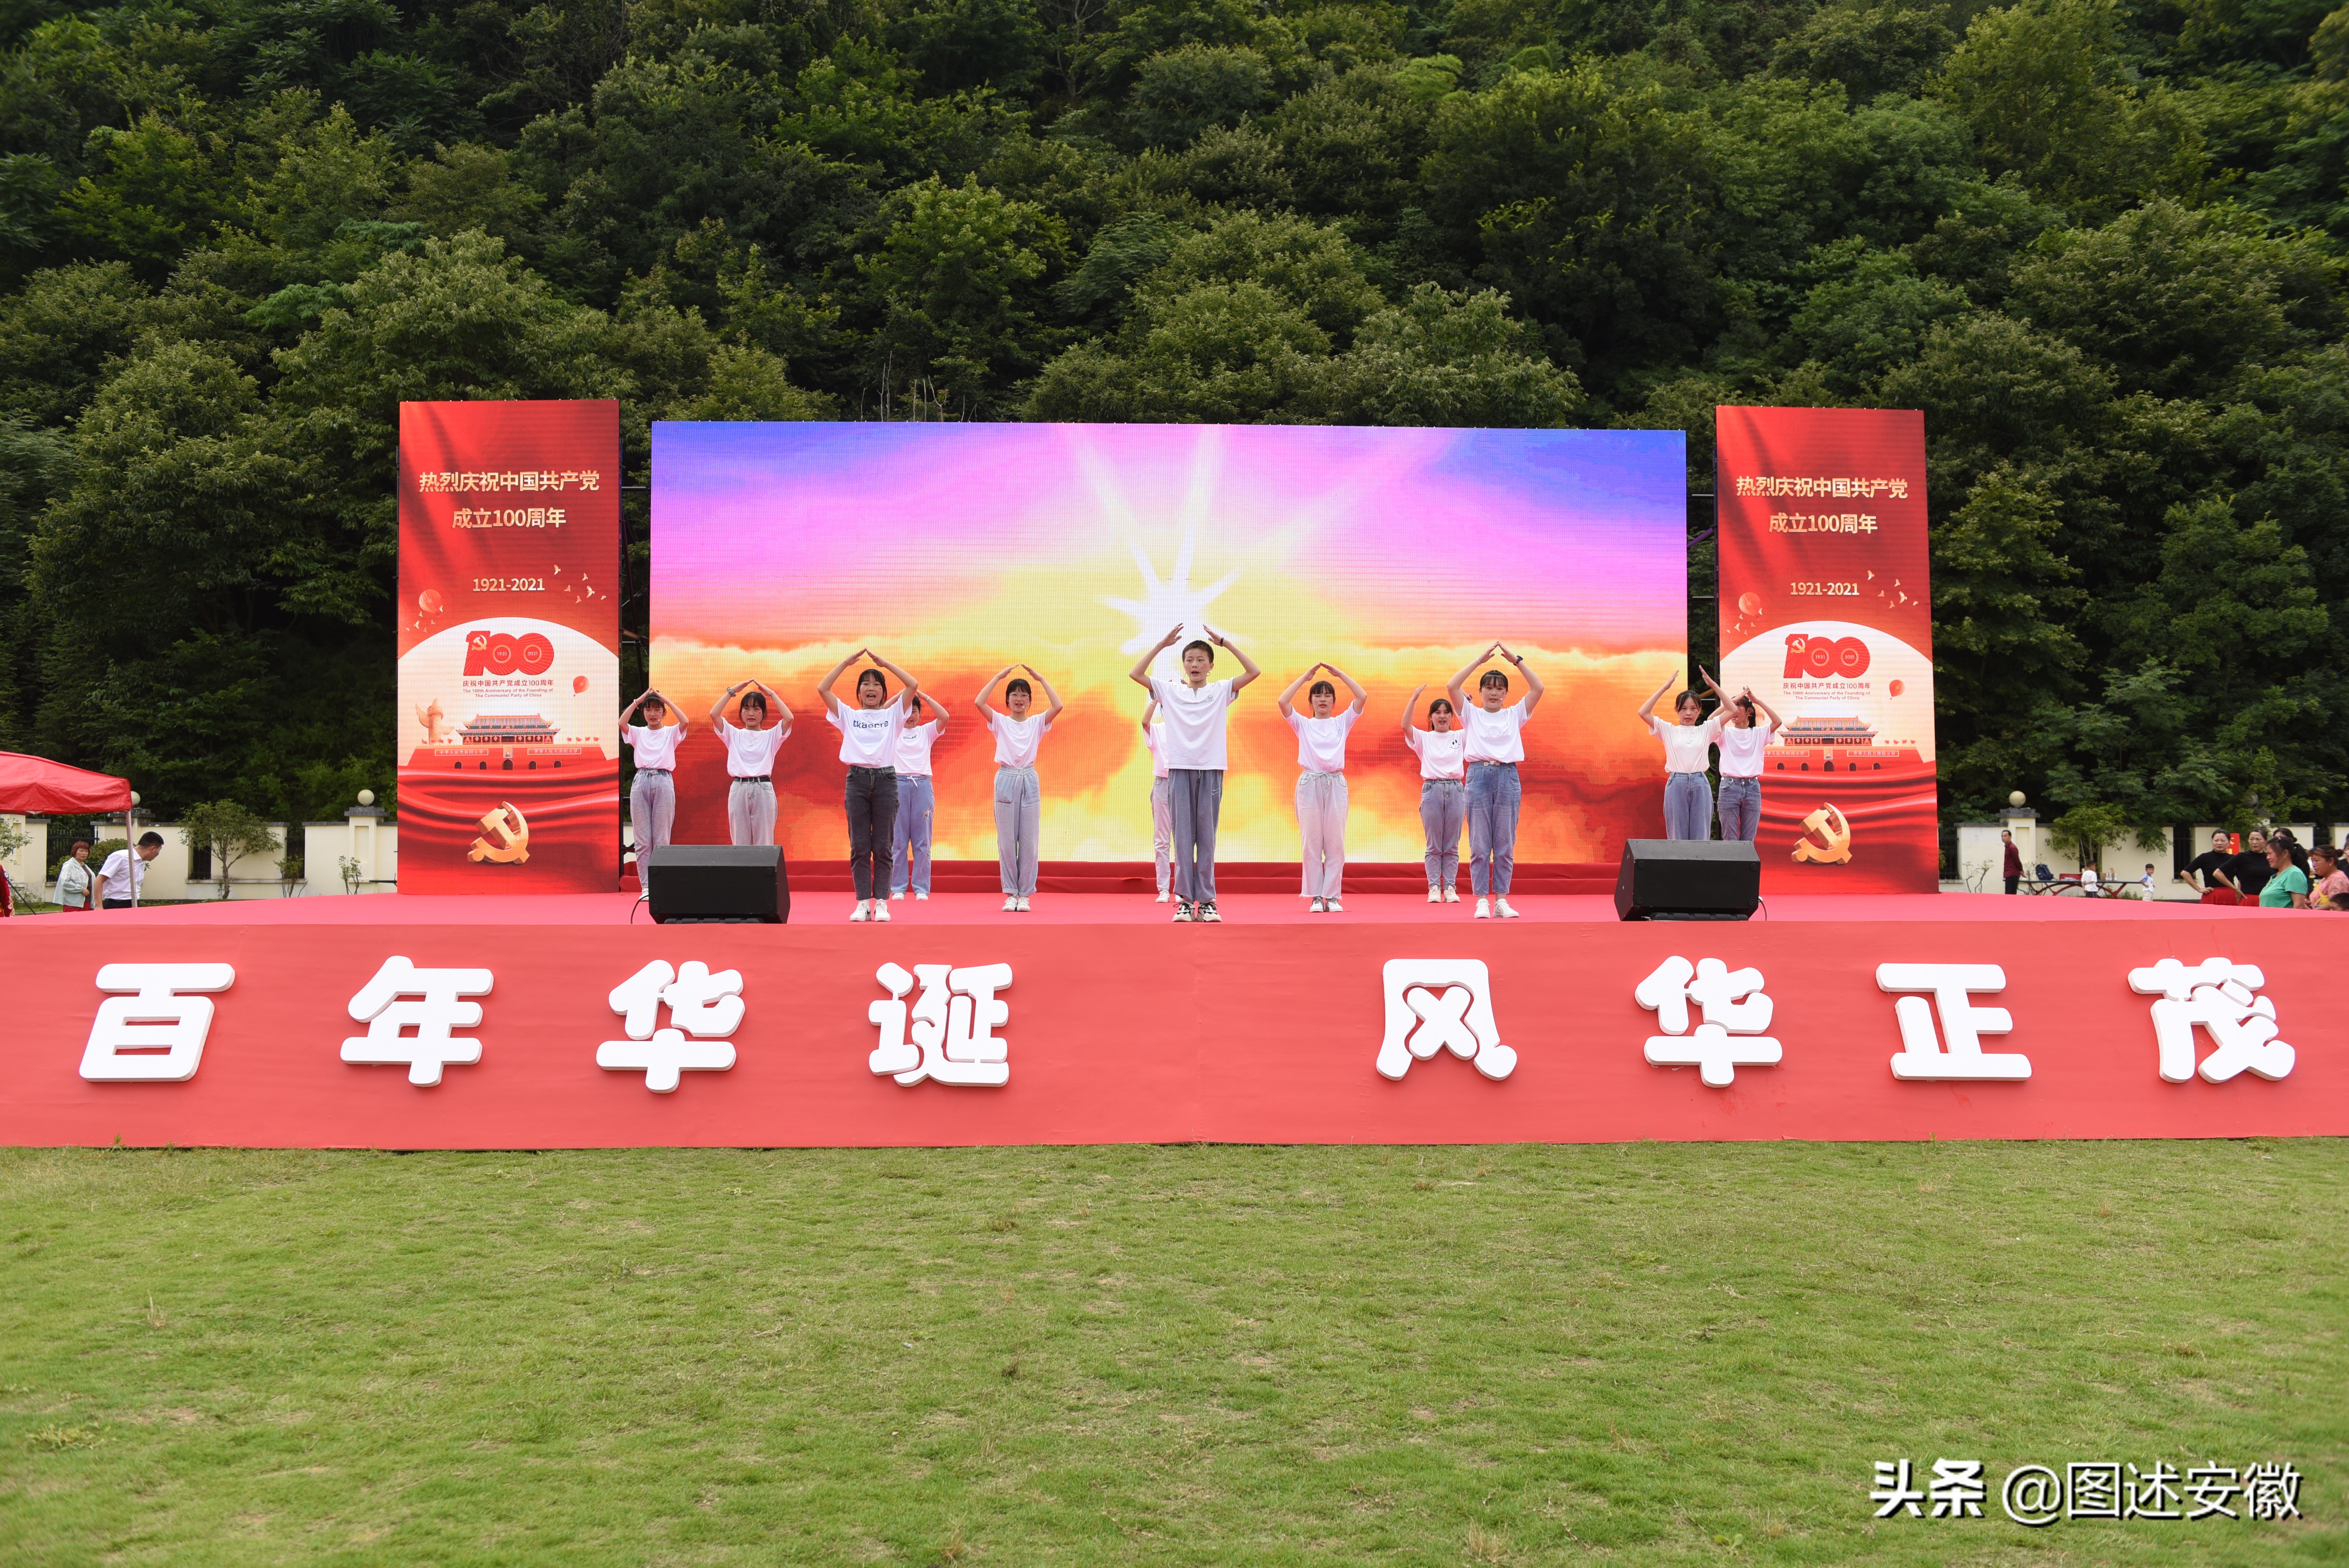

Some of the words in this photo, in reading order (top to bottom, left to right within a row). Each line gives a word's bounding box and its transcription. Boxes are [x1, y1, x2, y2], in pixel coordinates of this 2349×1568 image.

[419, 470, 600, 492] 热烈庆祝中国共产党
[1736, 476, 1908, 499] 热烈庆祝中国共产党
[452, 507, 566, 528] 成立100周年
[1769, 512, 1878, 534] 成立100周年
[473, 578, 545, 592] 1921-2021
[1790, 582, 1860, 595] 1921-2021
[79, 955, 1014, 1092] 百年华诞
[1376, 956, 2296, 1086] 风华正茂
